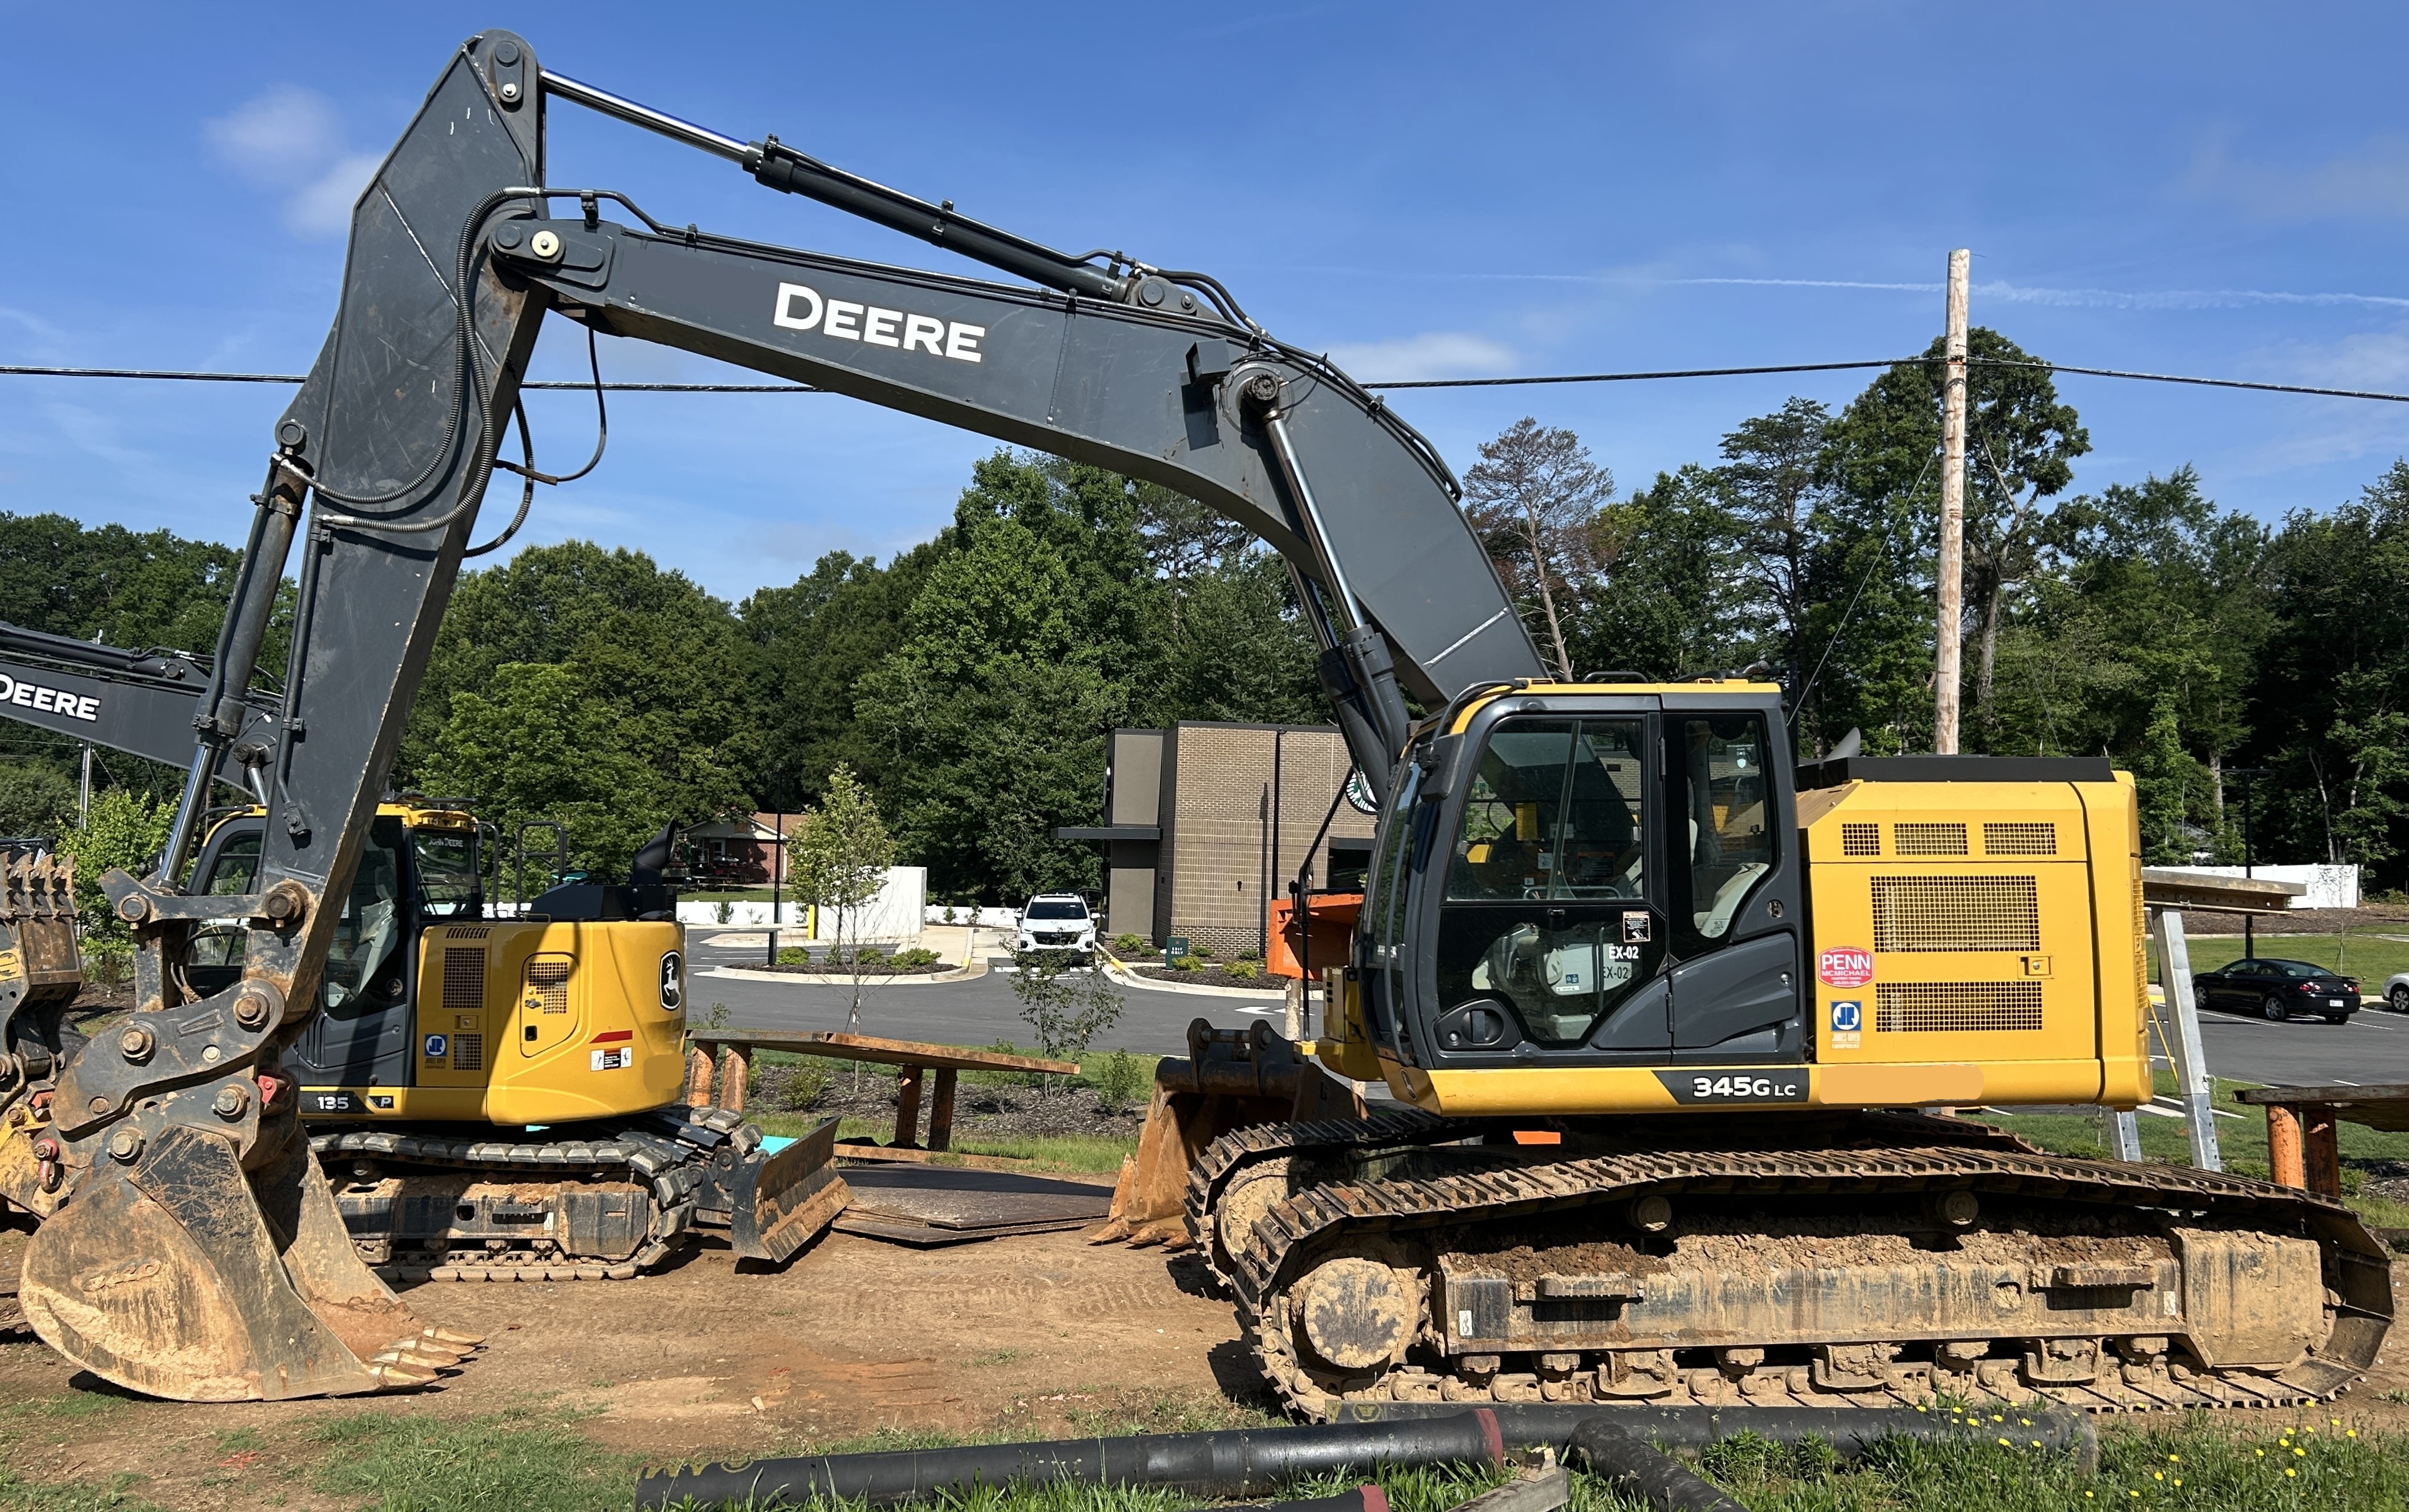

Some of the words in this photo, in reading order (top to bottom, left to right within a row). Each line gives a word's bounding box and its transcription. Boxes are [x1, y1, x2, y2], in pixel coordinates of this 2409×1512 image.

[773, 282, 986, 362] DEERE
[445, 838, 463, 847] DEERE
[1609, 946, 1639, 959] EX-02
[1821, 954, 1871, 970] PENN
[1694, 1077, 1770, 1097] 345G
[1774, 1085, 1796, 1096] LC
[317, 1097, 349, 1109] 135
[380, 1097, 392, 1107] P
